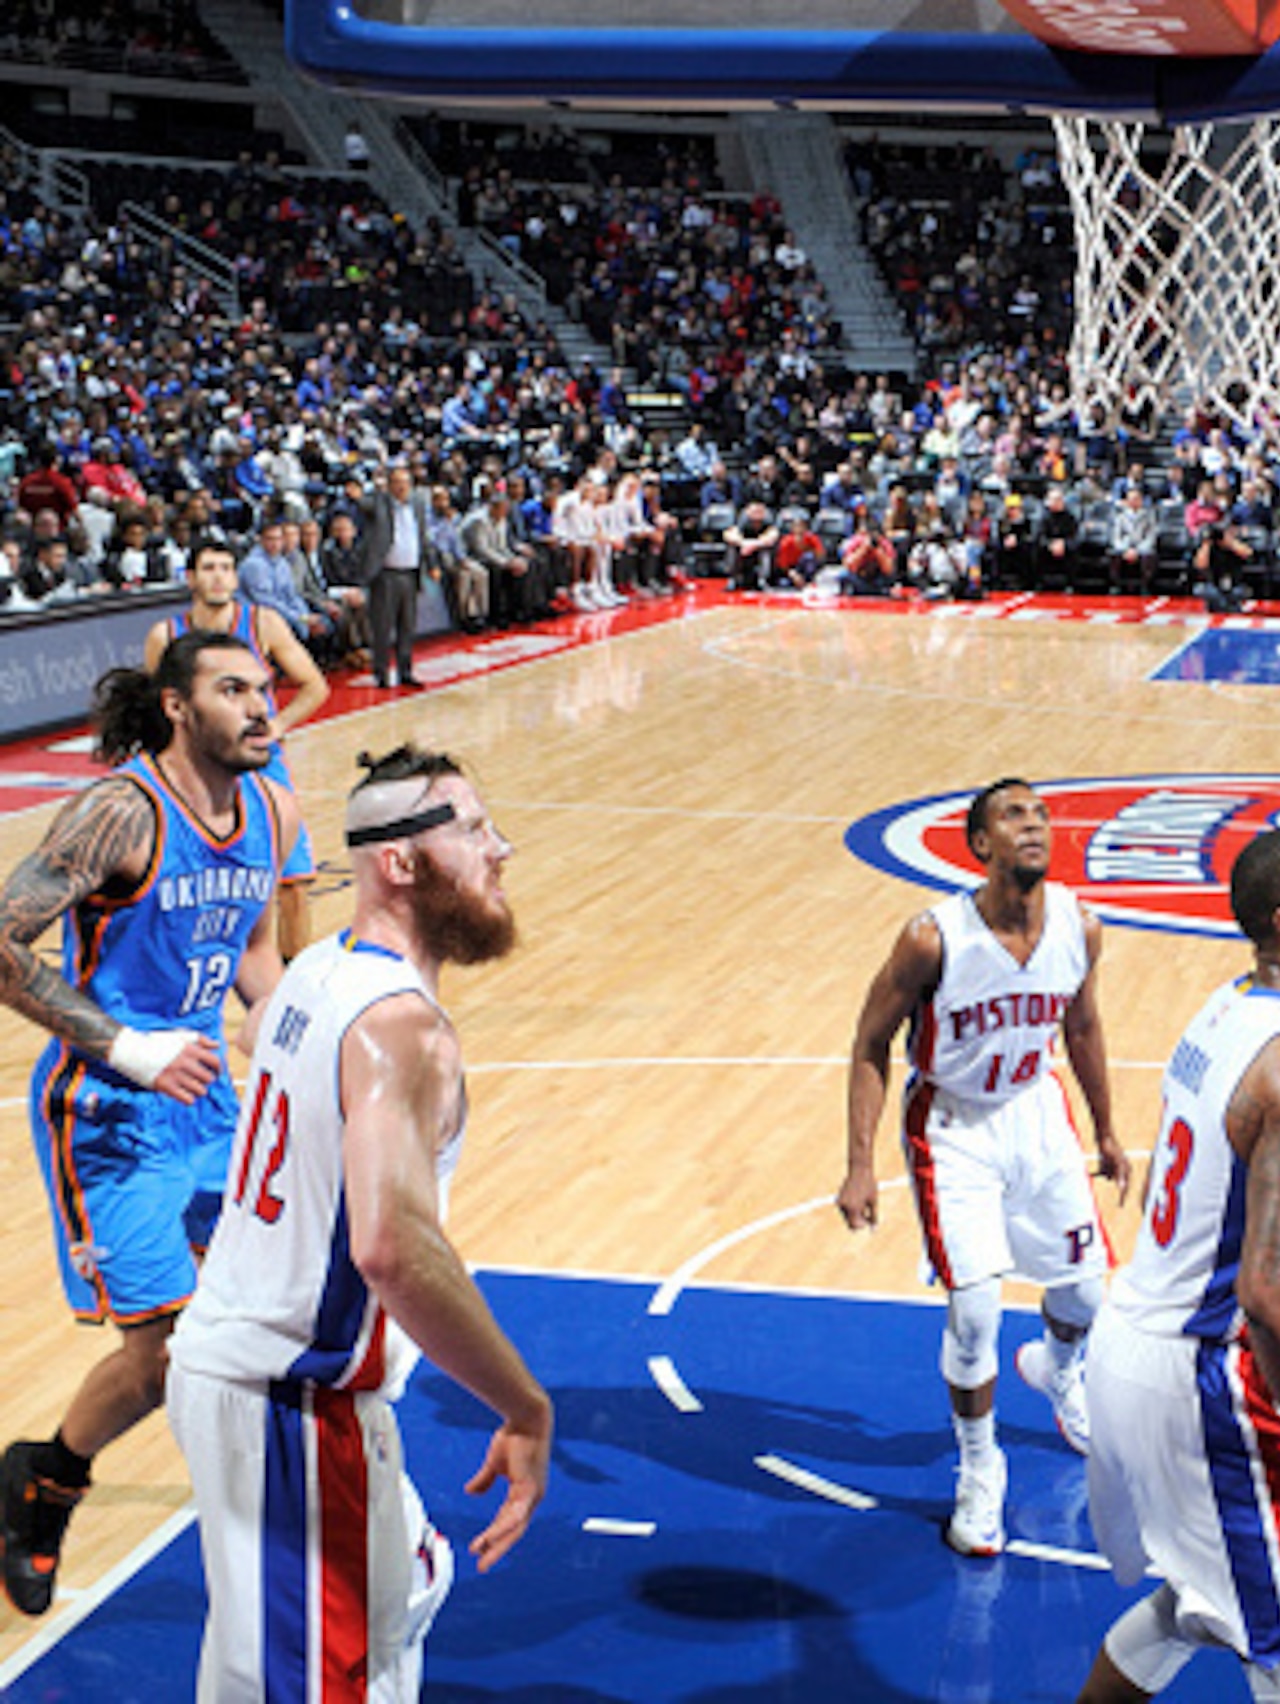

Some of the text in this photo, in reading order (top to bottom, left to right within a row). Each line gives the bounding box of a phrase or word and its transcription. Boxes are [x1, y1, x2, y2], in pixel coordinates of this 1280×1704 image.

[179, 953, 232, 1017] 12
[234, 1069, 291, 1224] 12
[1151, 1094, 1195, 1248] 3
[1064, 1222, 1094, 1265] P
